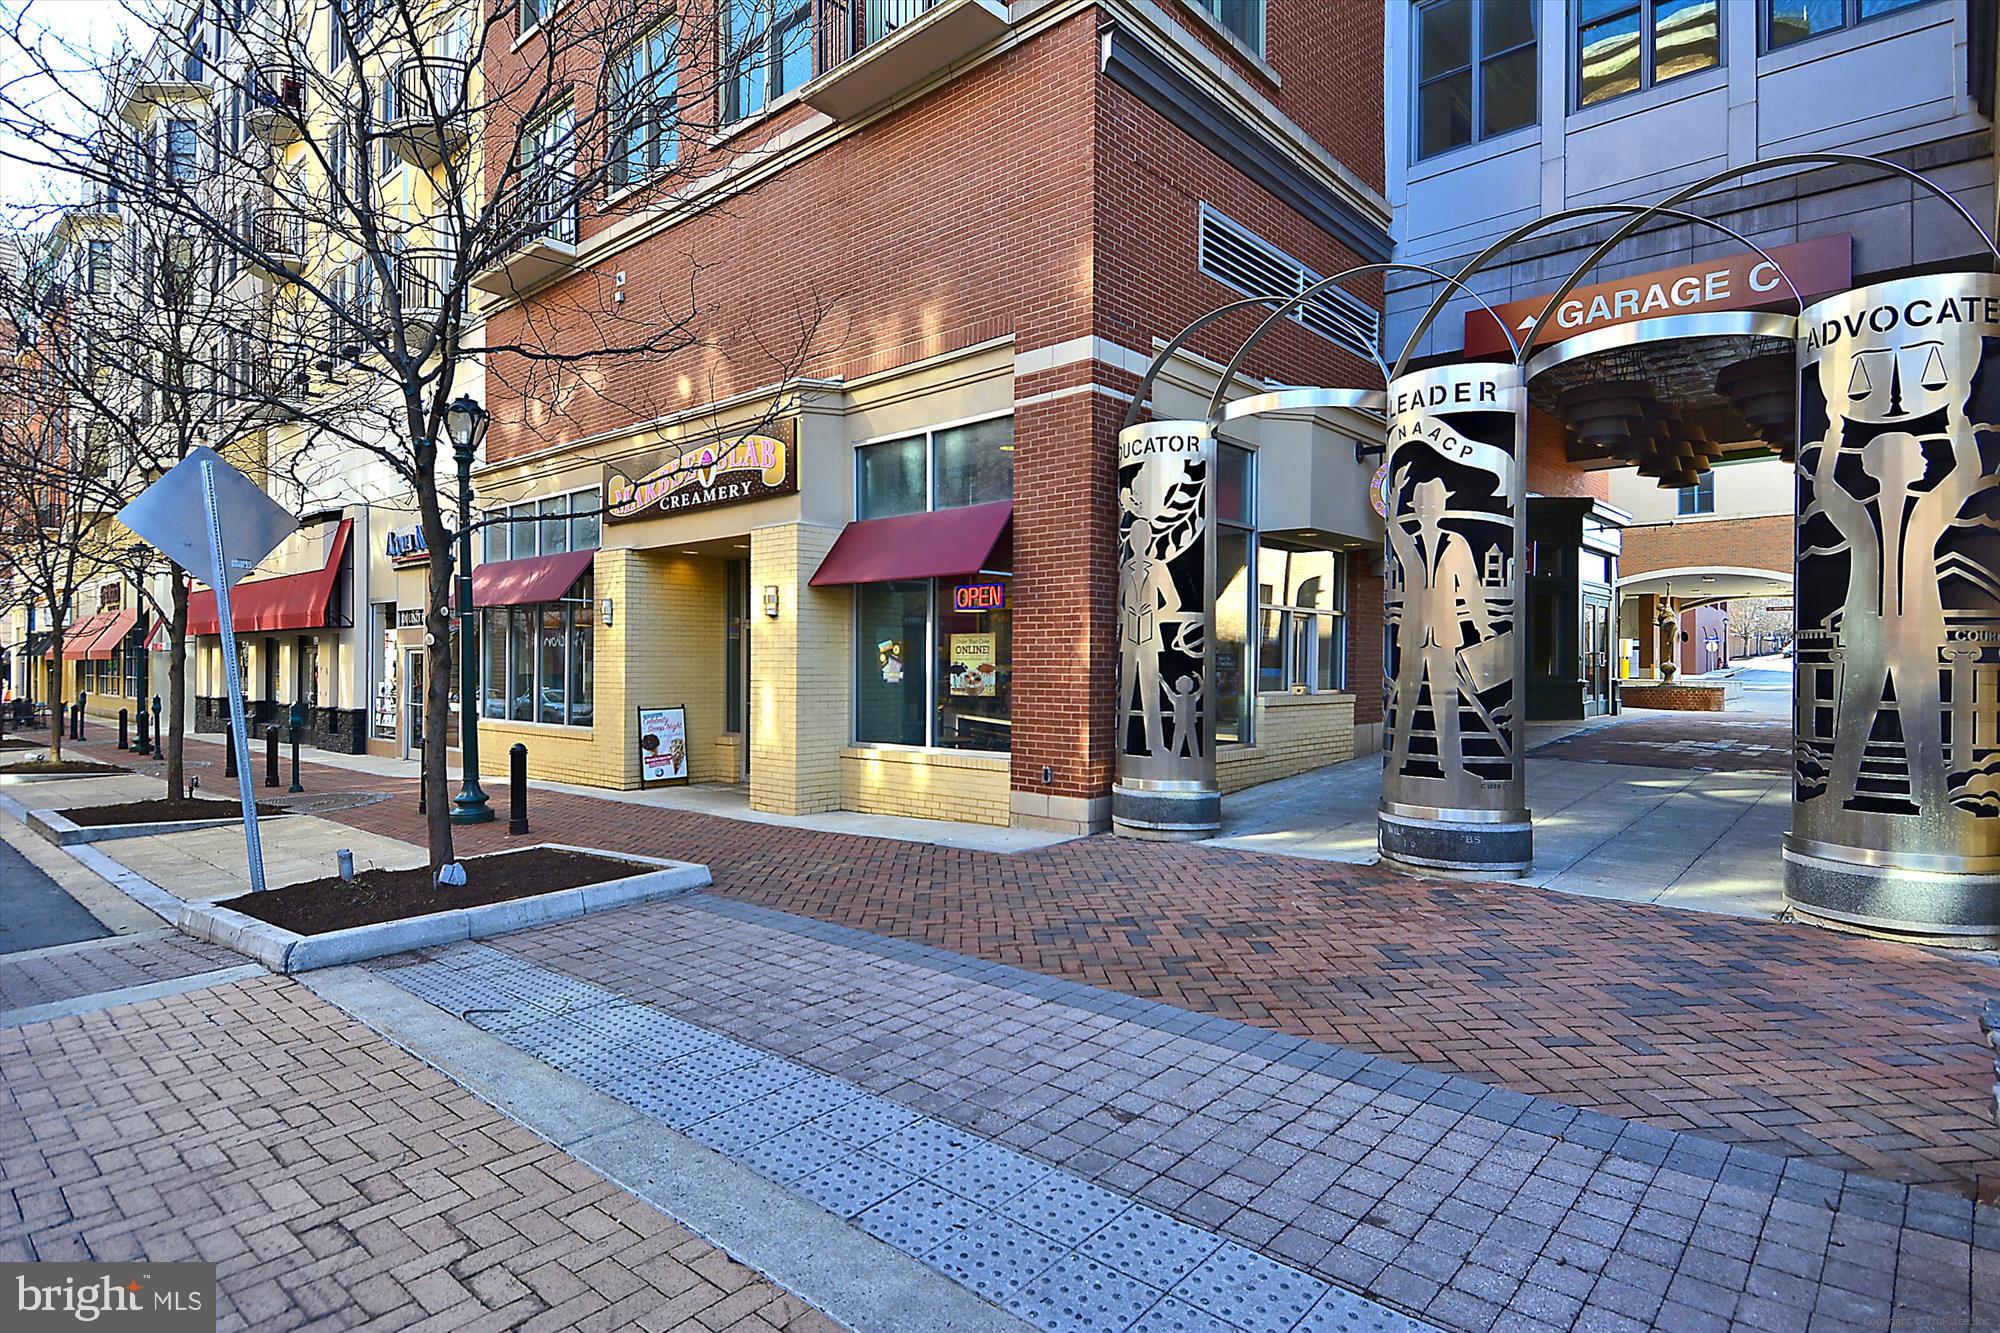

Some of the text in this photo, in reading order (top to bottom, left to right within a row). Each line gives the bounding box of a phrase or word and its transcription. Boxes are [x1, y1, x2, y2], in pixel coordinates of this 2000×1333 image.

[1556, 261, 1781, 329] GARAGE C
[1806, 296, 1999, 353] ADVOCATE
[1389, 381, 1497, 418] LEADER
[1397, 421, 1474, 459] NAACP
[613, 437, 776, 514] MARBLE SLAB
[659, 480, 753, 511] CREAMERY
[957, 585, 1001, 607] OPEN
[955, 645, 990, 655] ONLINE!
